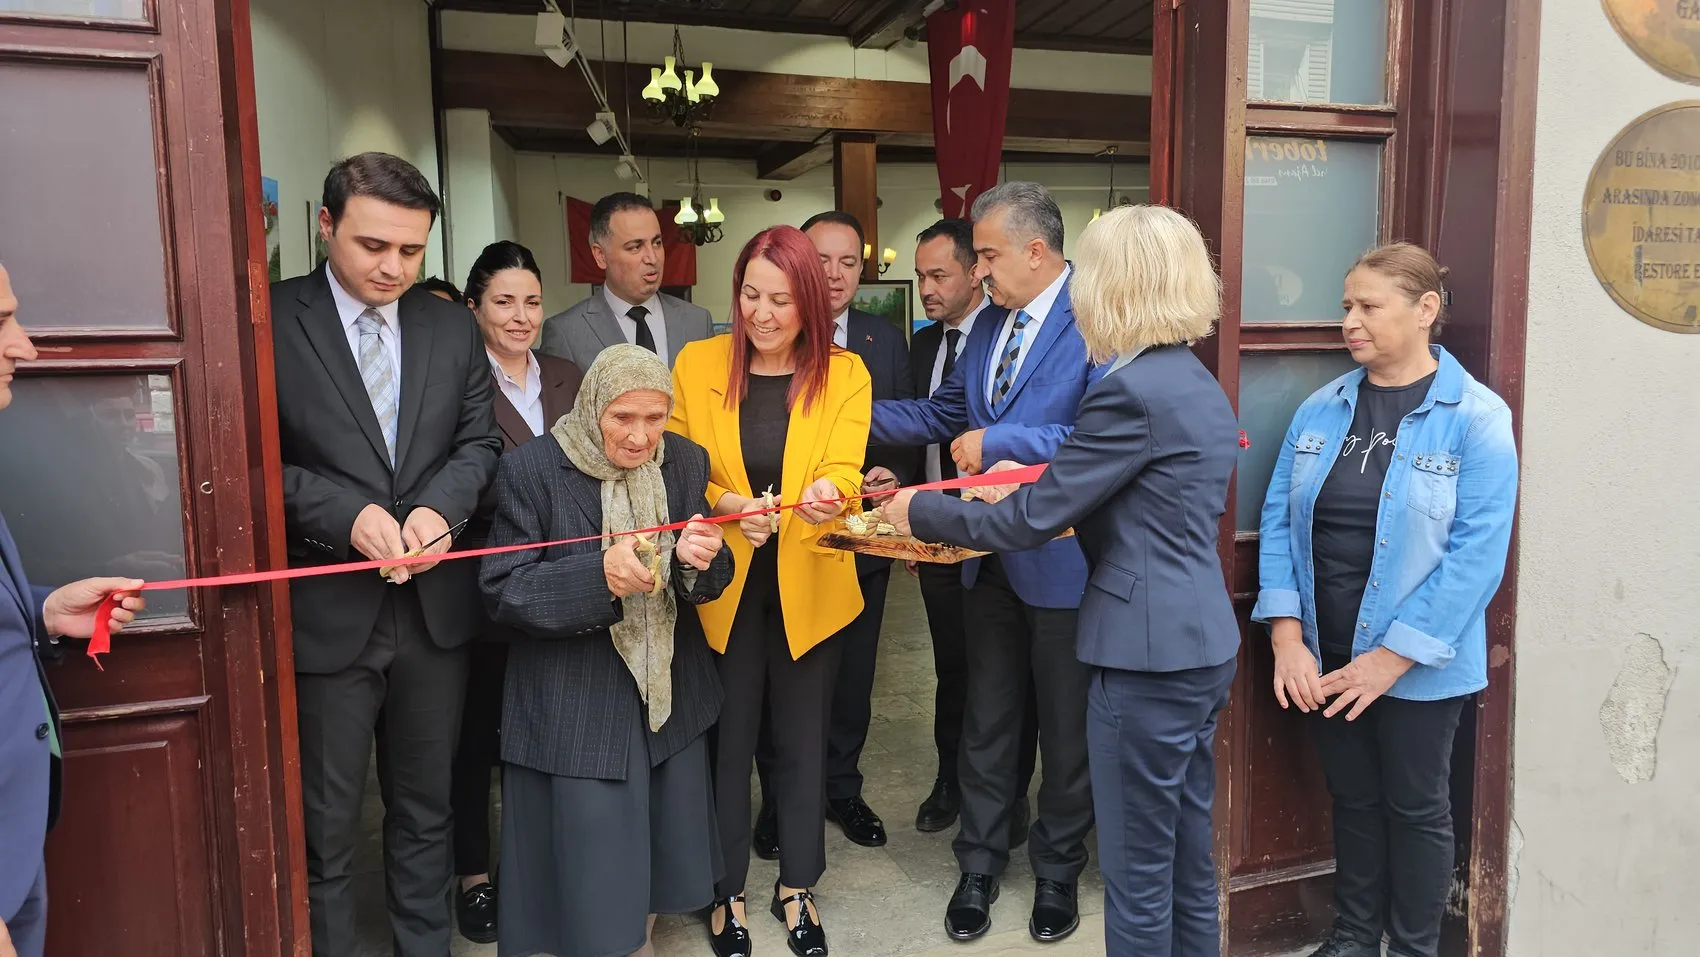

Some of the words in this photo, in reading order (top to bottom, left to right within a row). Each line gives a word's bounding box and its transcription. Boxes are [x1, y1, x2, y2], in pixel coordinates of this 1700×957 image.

[1615, 150, 1633, 167] BU
[1636, 146, 1666, 169] BİNA
[1602, 187, 1669, 206] ARASINDA
[1673, 190, 1700, 206] ZON
[1632, 220, 1684, 243] İDARESİ
[1634, 262, 1690, 280] RESTORE
